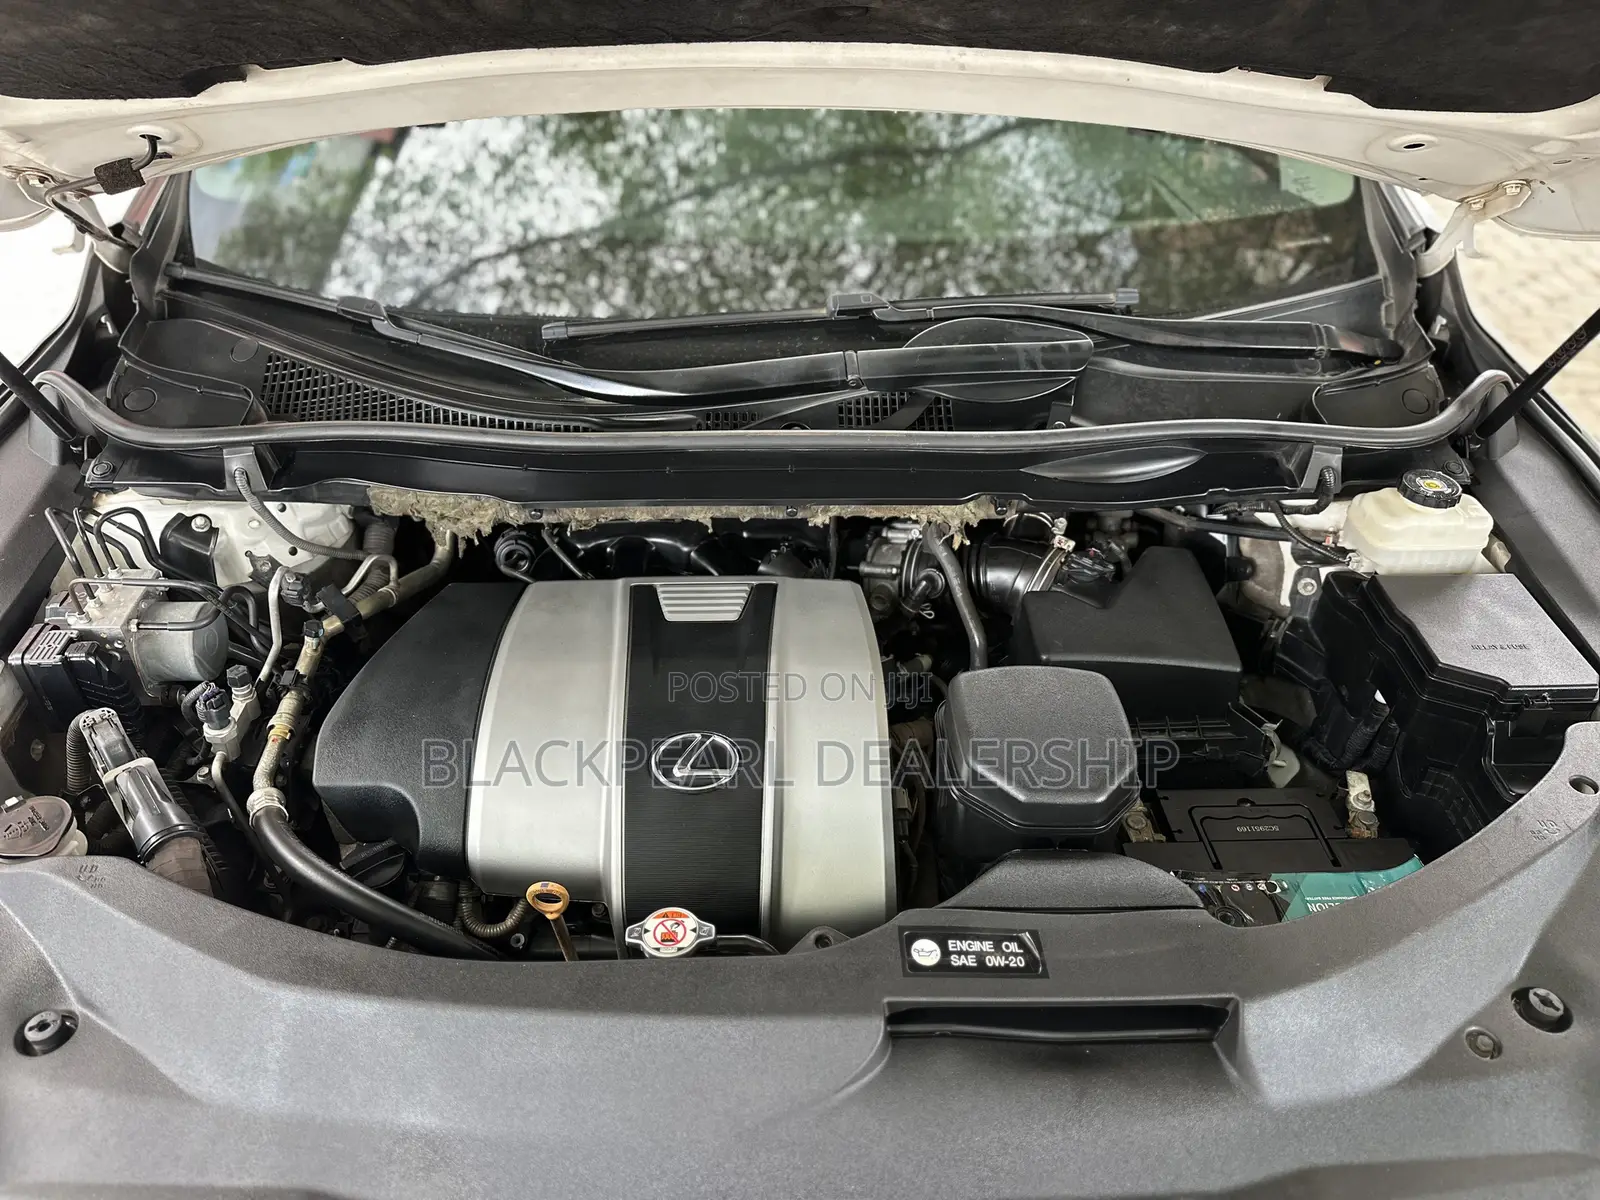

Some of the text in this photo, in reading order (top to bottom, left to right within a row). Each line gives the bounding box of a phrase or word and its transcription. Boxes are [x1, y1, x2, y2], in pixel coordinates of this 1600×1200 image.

[948, 940, 1024, 953] ENGINE OIL
[950, 955, 1026, 968] SAE 0W-20
